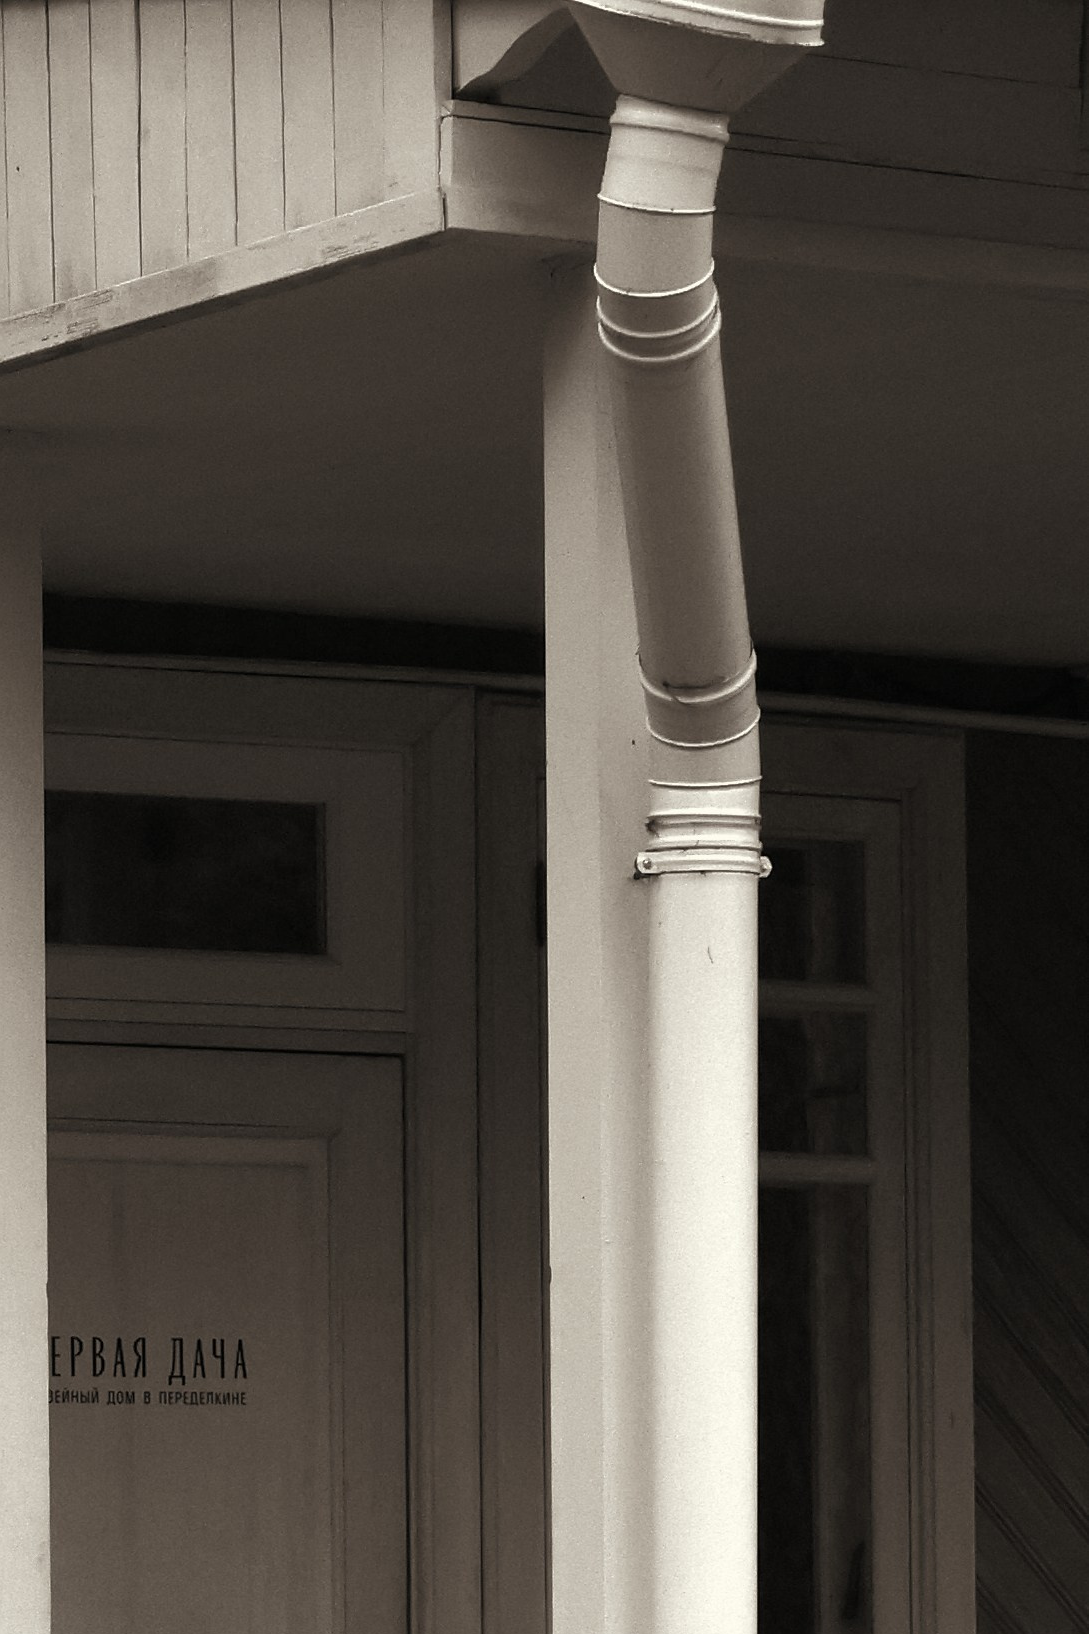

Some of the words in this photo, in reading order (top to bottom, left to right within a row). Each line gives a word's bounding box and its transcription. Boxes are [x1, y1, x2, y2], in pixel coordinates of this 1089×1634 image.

[51, 1336, 147, 1378] ЕРВАЯ
[168, 1337, 248, 1386] ДАЧА
[106, 1390, 135, 1405] ДОМ
[143, 1391, 151, 1404] В
[159, 1391, 247, 1406] ПЕРЕДЕЛКИНЕ
